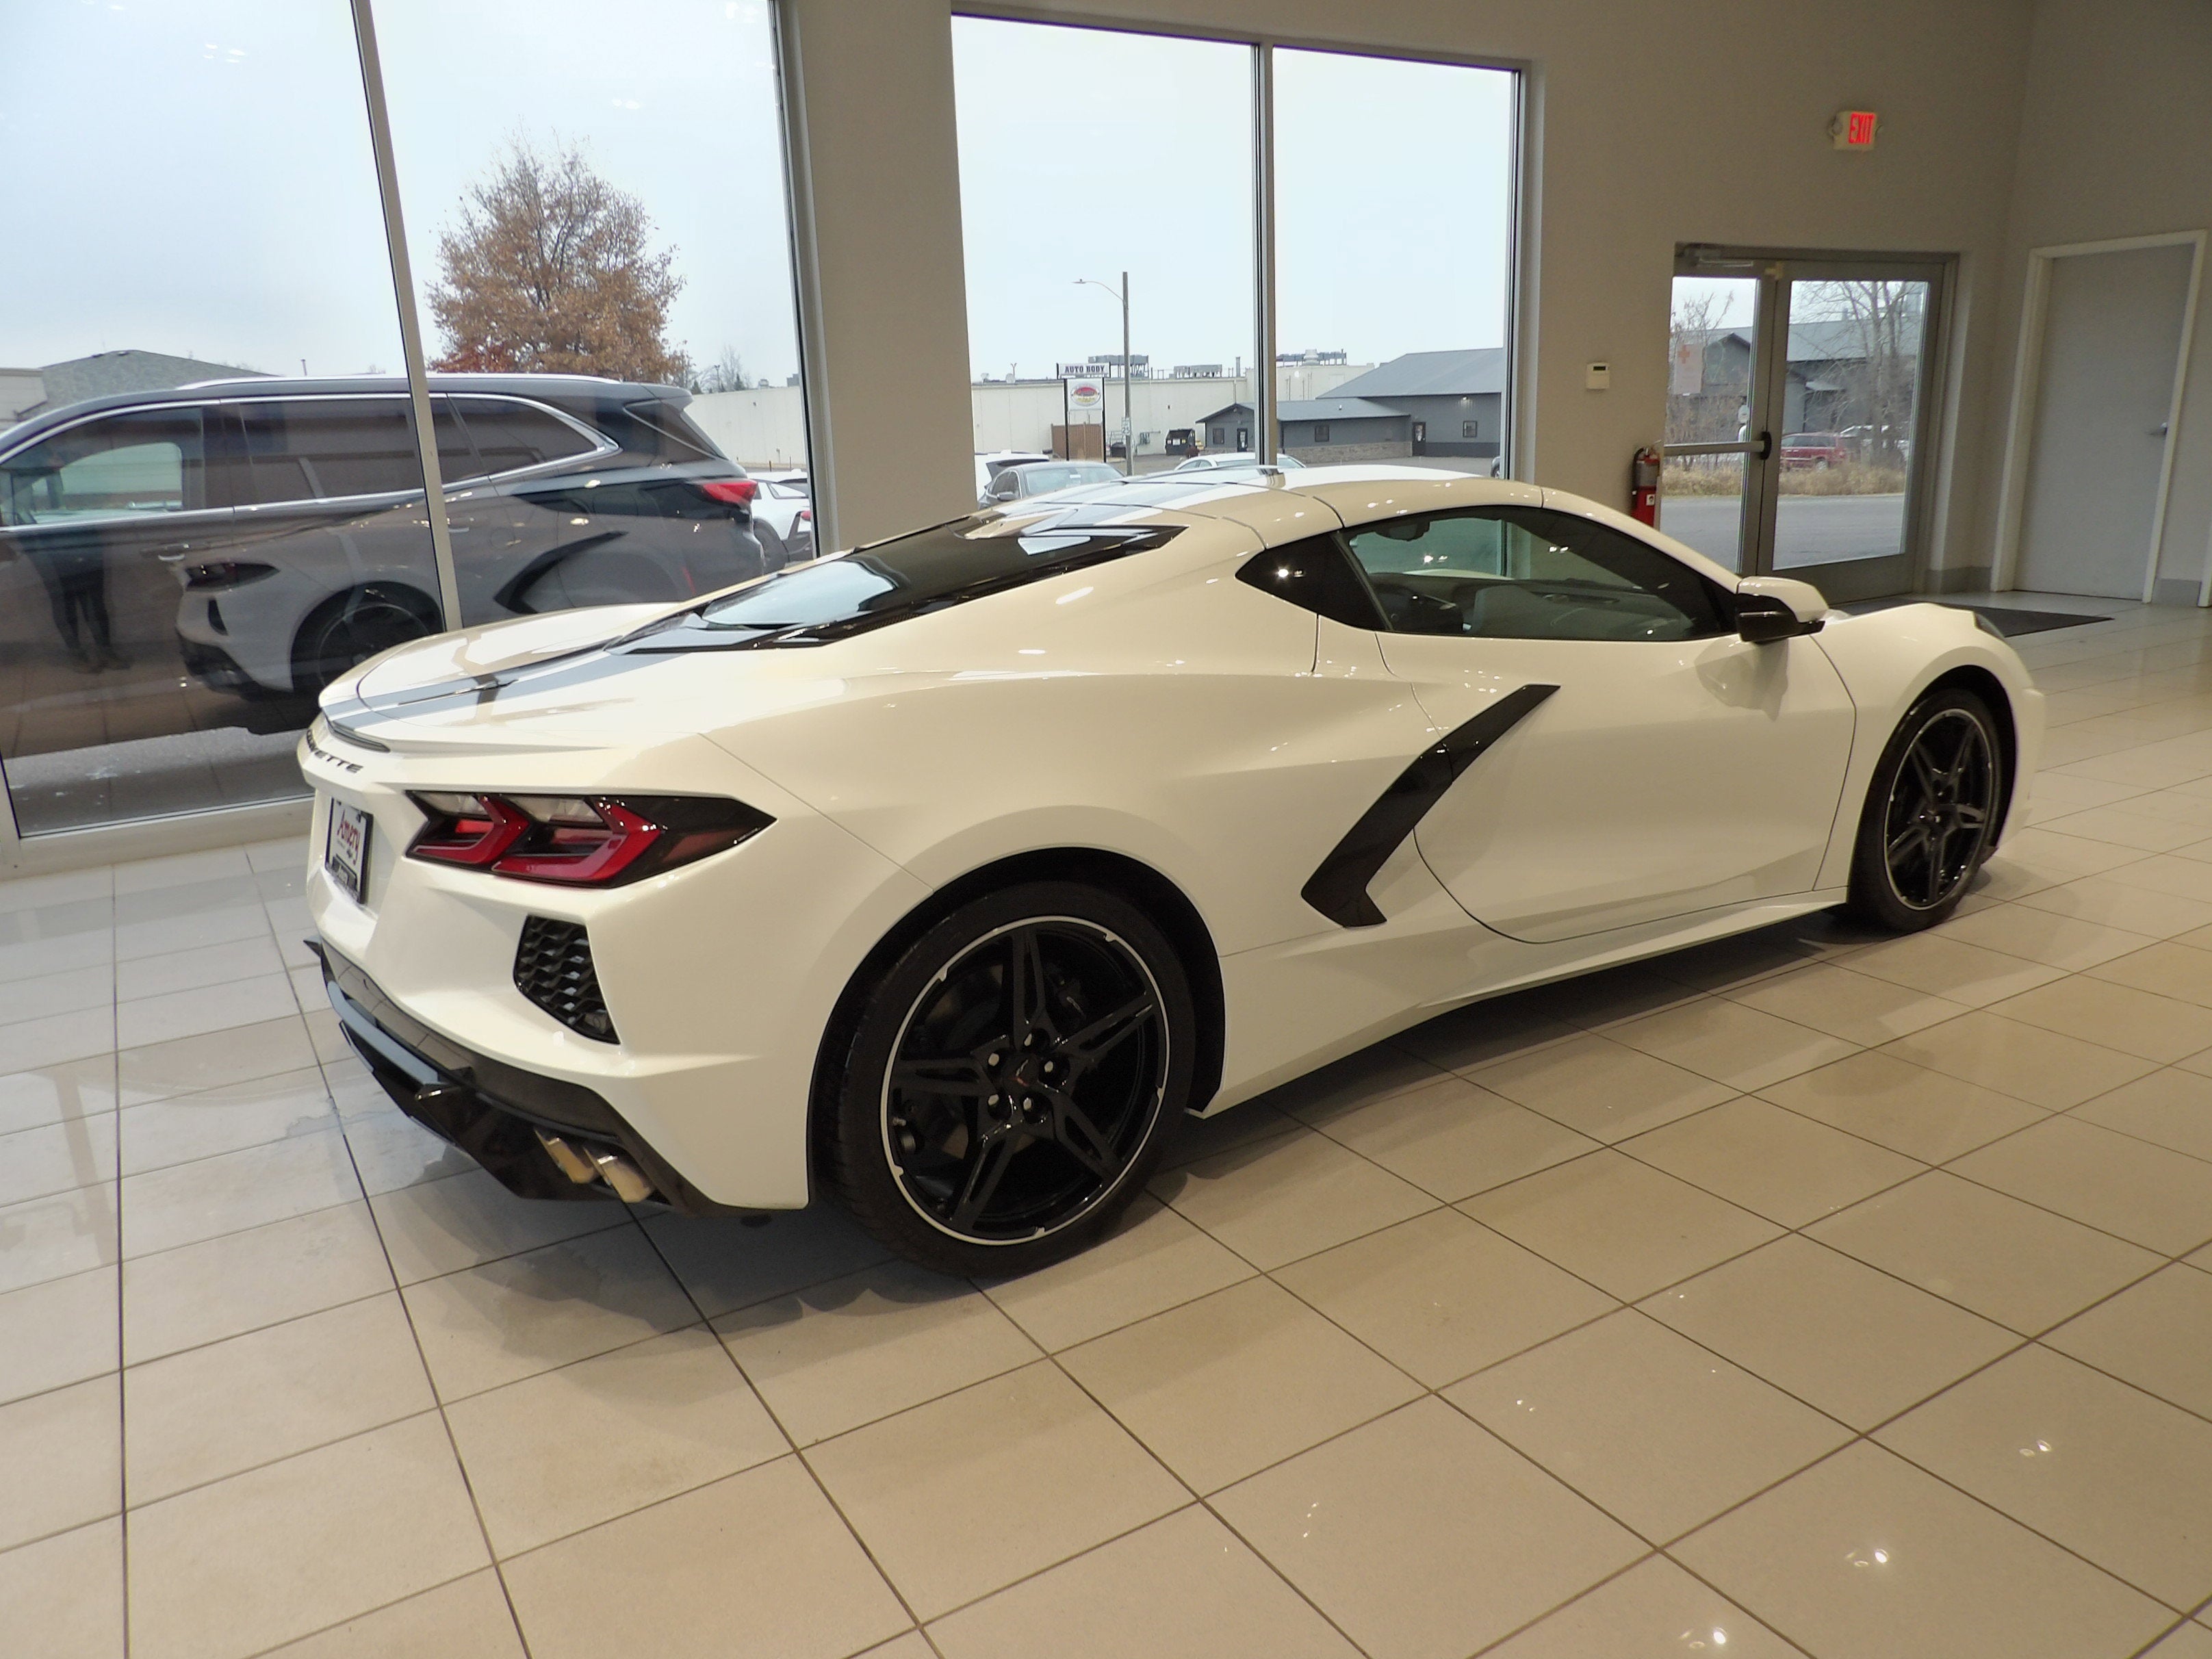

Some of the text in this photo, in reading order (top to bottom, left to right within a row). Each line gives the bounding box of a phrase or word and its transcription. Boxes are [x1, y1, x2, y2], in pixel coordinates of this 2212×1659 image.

[1849, 112, 1874, 143] EXIT
[1065, 365, 1105, 373] AUTO BODY
